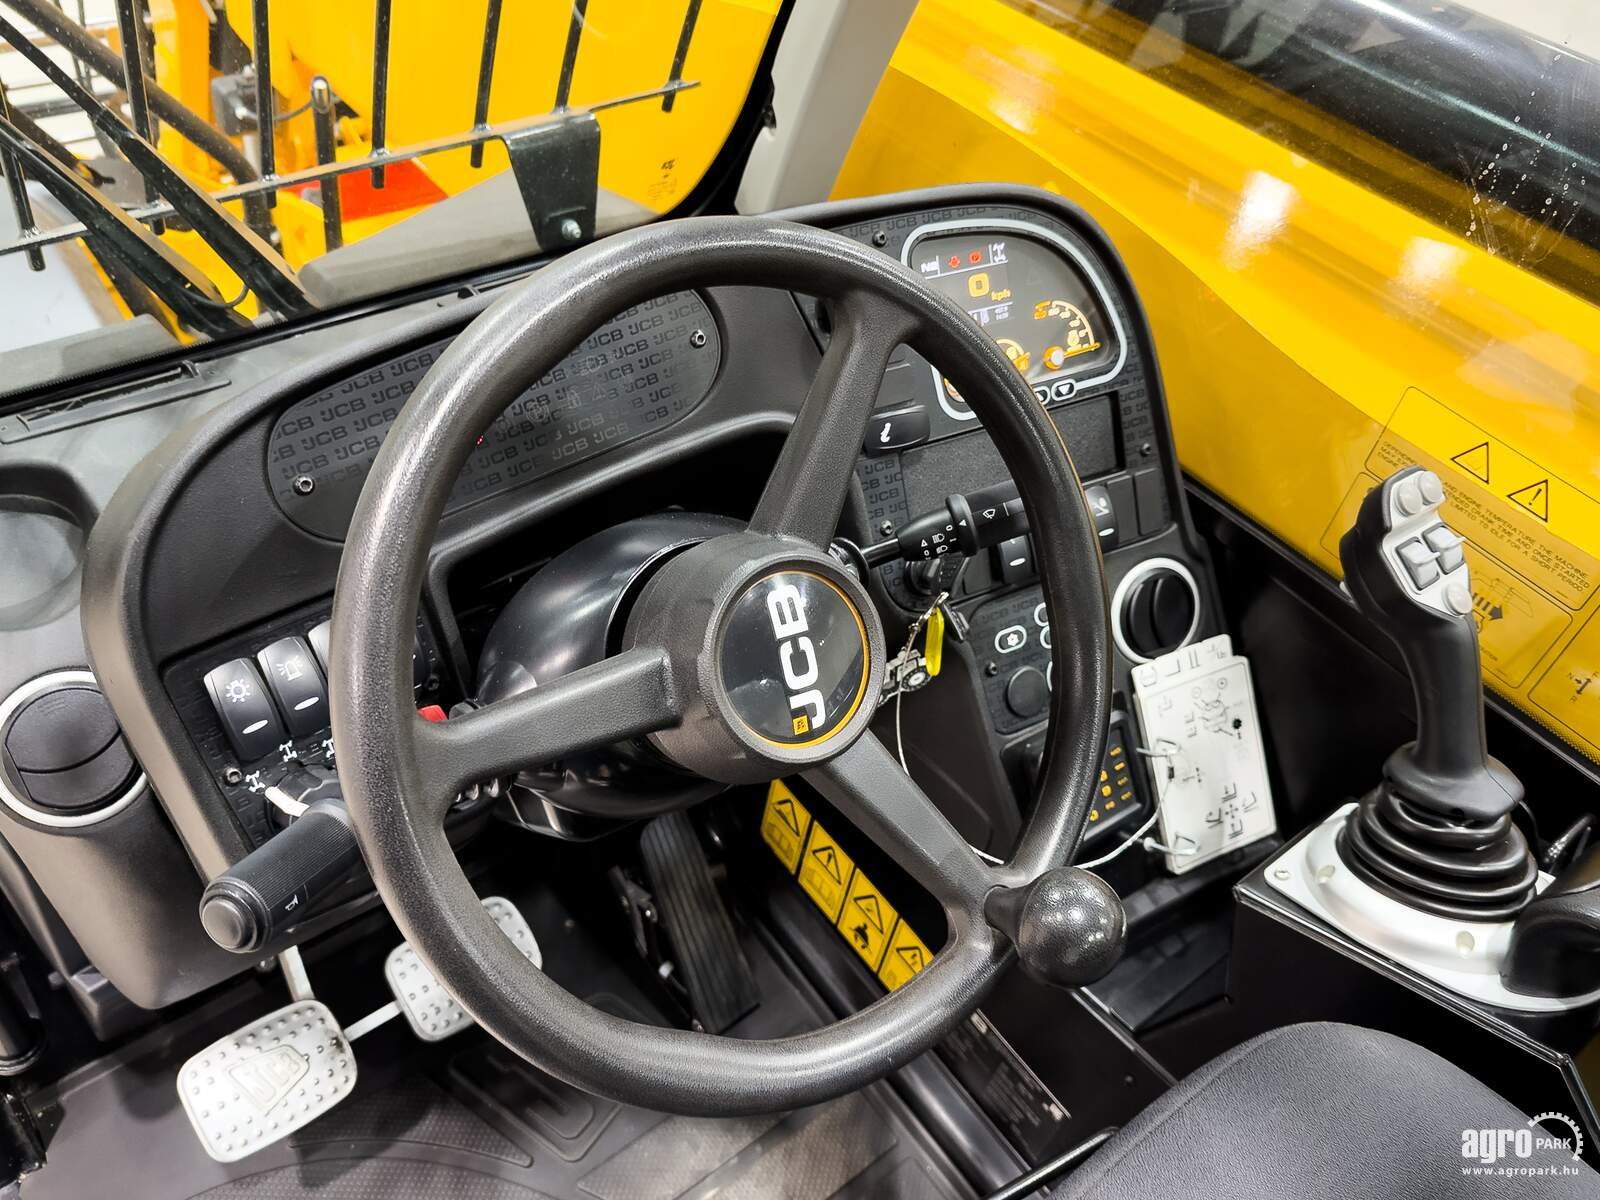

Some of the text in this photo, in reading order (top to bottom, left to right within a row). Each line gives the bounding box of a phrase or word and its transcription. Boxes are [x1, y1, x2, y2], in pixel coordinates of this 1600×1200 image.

[887, 215, 917, 231] JCB
[921, 209, 952, 223] JCB
[968, 272, 990, 297] 0
[587, 328, 624, 350] JCB
[628, 314, 665, 336] JCB
[613, 338, 649, 359] JCB
[652, 324, 688, 346] JCB
[389, 353, 434, 377] JCB
[638, 348, 674, 370] JCB
[275, 415, 315, 440] CB
[320, 398, 367, 422] JCB
[371, 380, 416, 404] JCB
[301, 407, 399, 451] JCB JCB
[478, 445, 519, 470] JCB
[567, 412, 606, 435] JCB
[495, 420, 536, 443] JCB
[592, 421, 631, 445] JCB
[281, 435, 381, 480] JCB JCB
[864, 459, 895, 475] JCB
[869, 487, 899, 504] JCB
[1530, 555, 1557, 574] SHORT
[1557, 573, 1584, 592] PERIOD
[1553, 562, 1591, 588] STARTED
[1555, 554, 1589, 579] MACHINE
[767, 584, 826, 736] JCB
